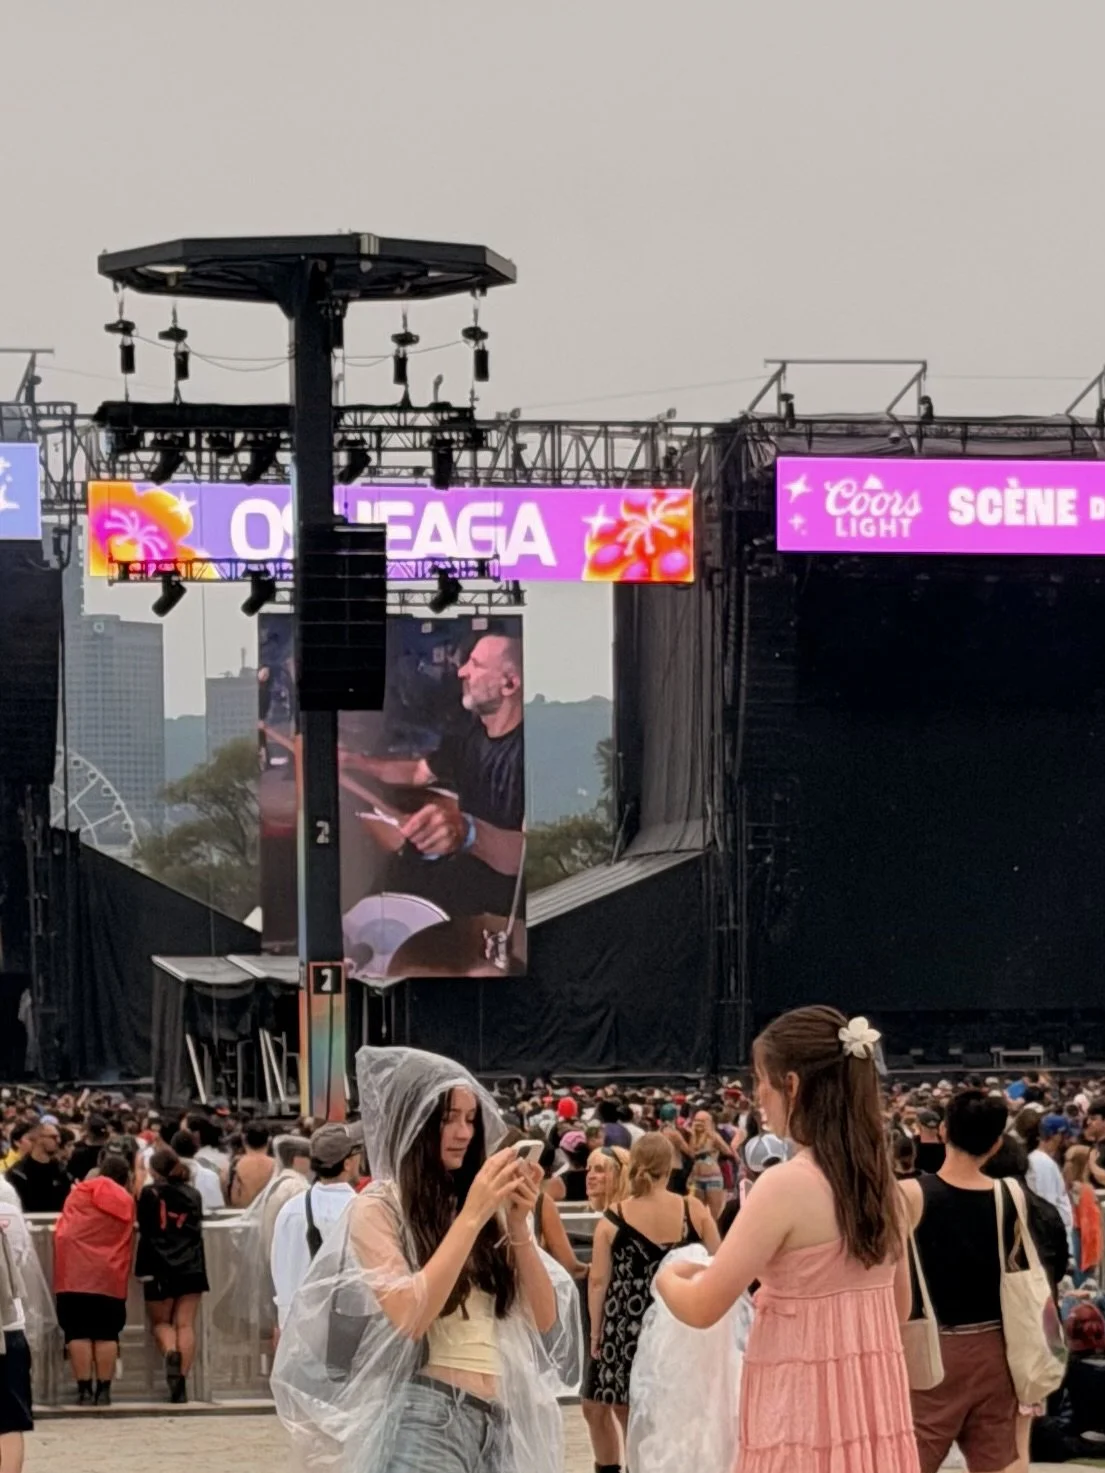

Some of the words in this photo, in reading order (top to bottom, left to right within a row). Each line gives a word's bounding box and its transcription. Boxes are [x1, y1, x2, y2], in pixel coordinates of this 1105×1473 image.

[823, 477, 924, 518] Coors
[949, 477, 1078, 526] SCÈNE
[834, 517, 913, 539] LIGHT
[316, 819, 331, 845] 2
